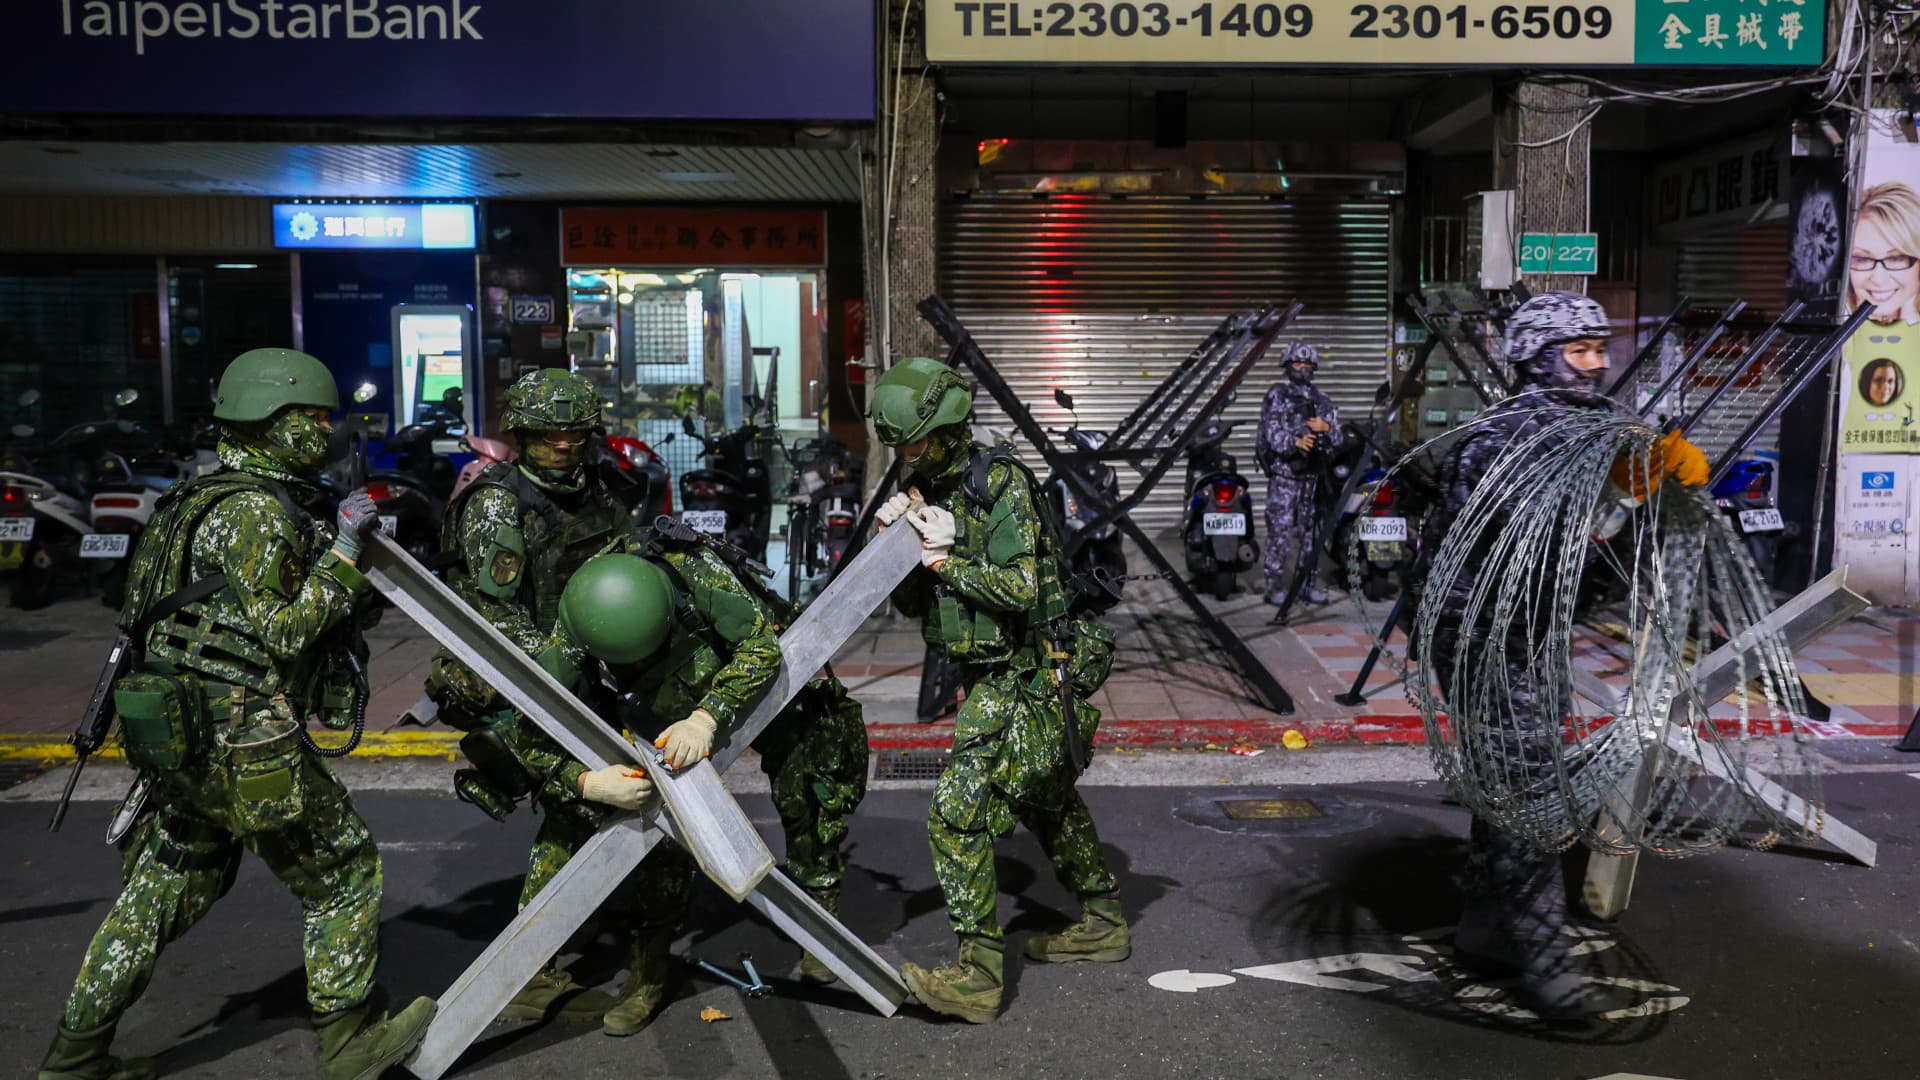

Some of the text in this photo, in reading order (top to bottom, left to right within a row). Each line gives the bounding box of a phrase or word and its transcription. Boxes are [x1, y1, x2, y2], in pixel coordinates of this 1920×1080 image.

[61, 0, 484, 55] TaipeiStarBank
[1350, 4, 1612, 39] 2301-6509
[516, 304, 547, 319] 223
